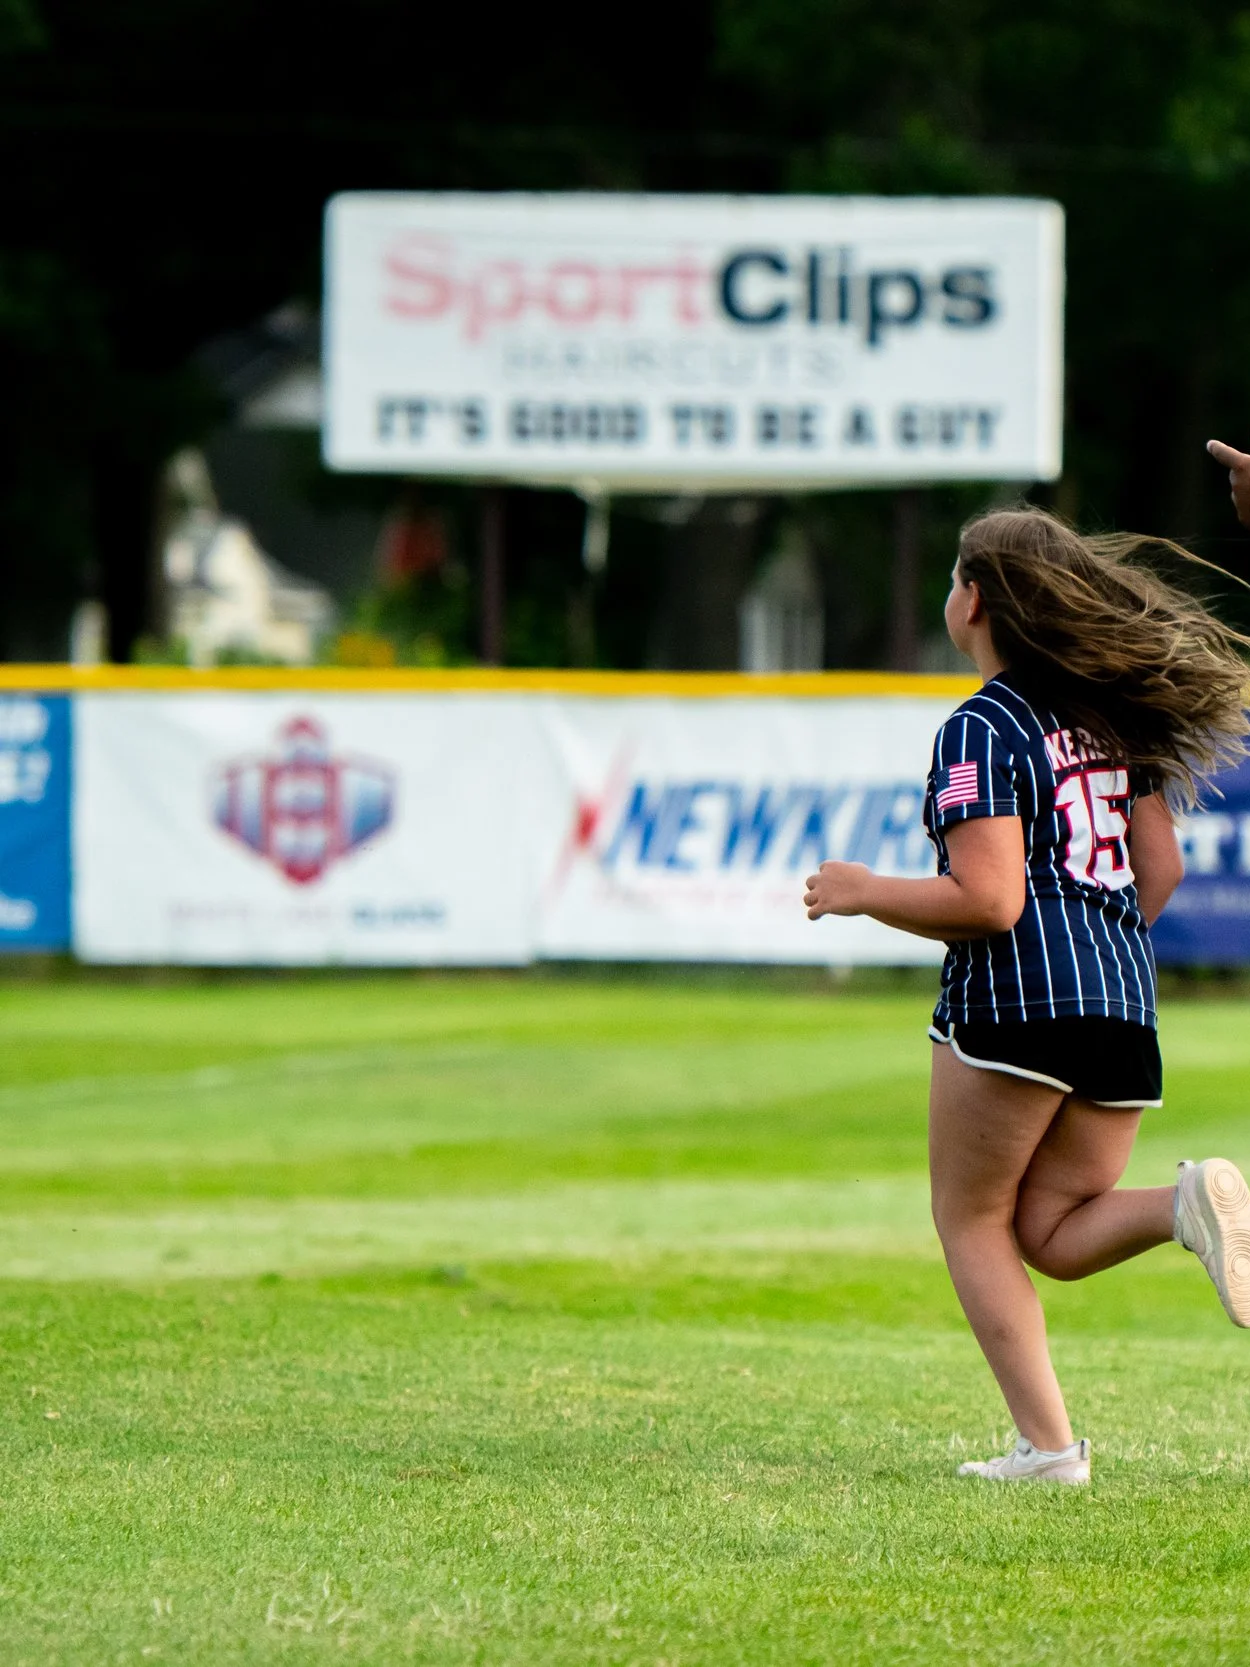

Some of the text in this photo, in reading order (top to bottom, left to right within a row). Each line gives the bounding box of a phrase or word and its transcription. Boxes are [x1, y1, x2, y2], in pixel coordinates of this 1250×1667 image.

[374, 394, 1003, 451] IT'S GOOD TO BE A GUY
[603, 775, 936, 871] NEWKIR
[1054, 768, 1135, 892] 15
